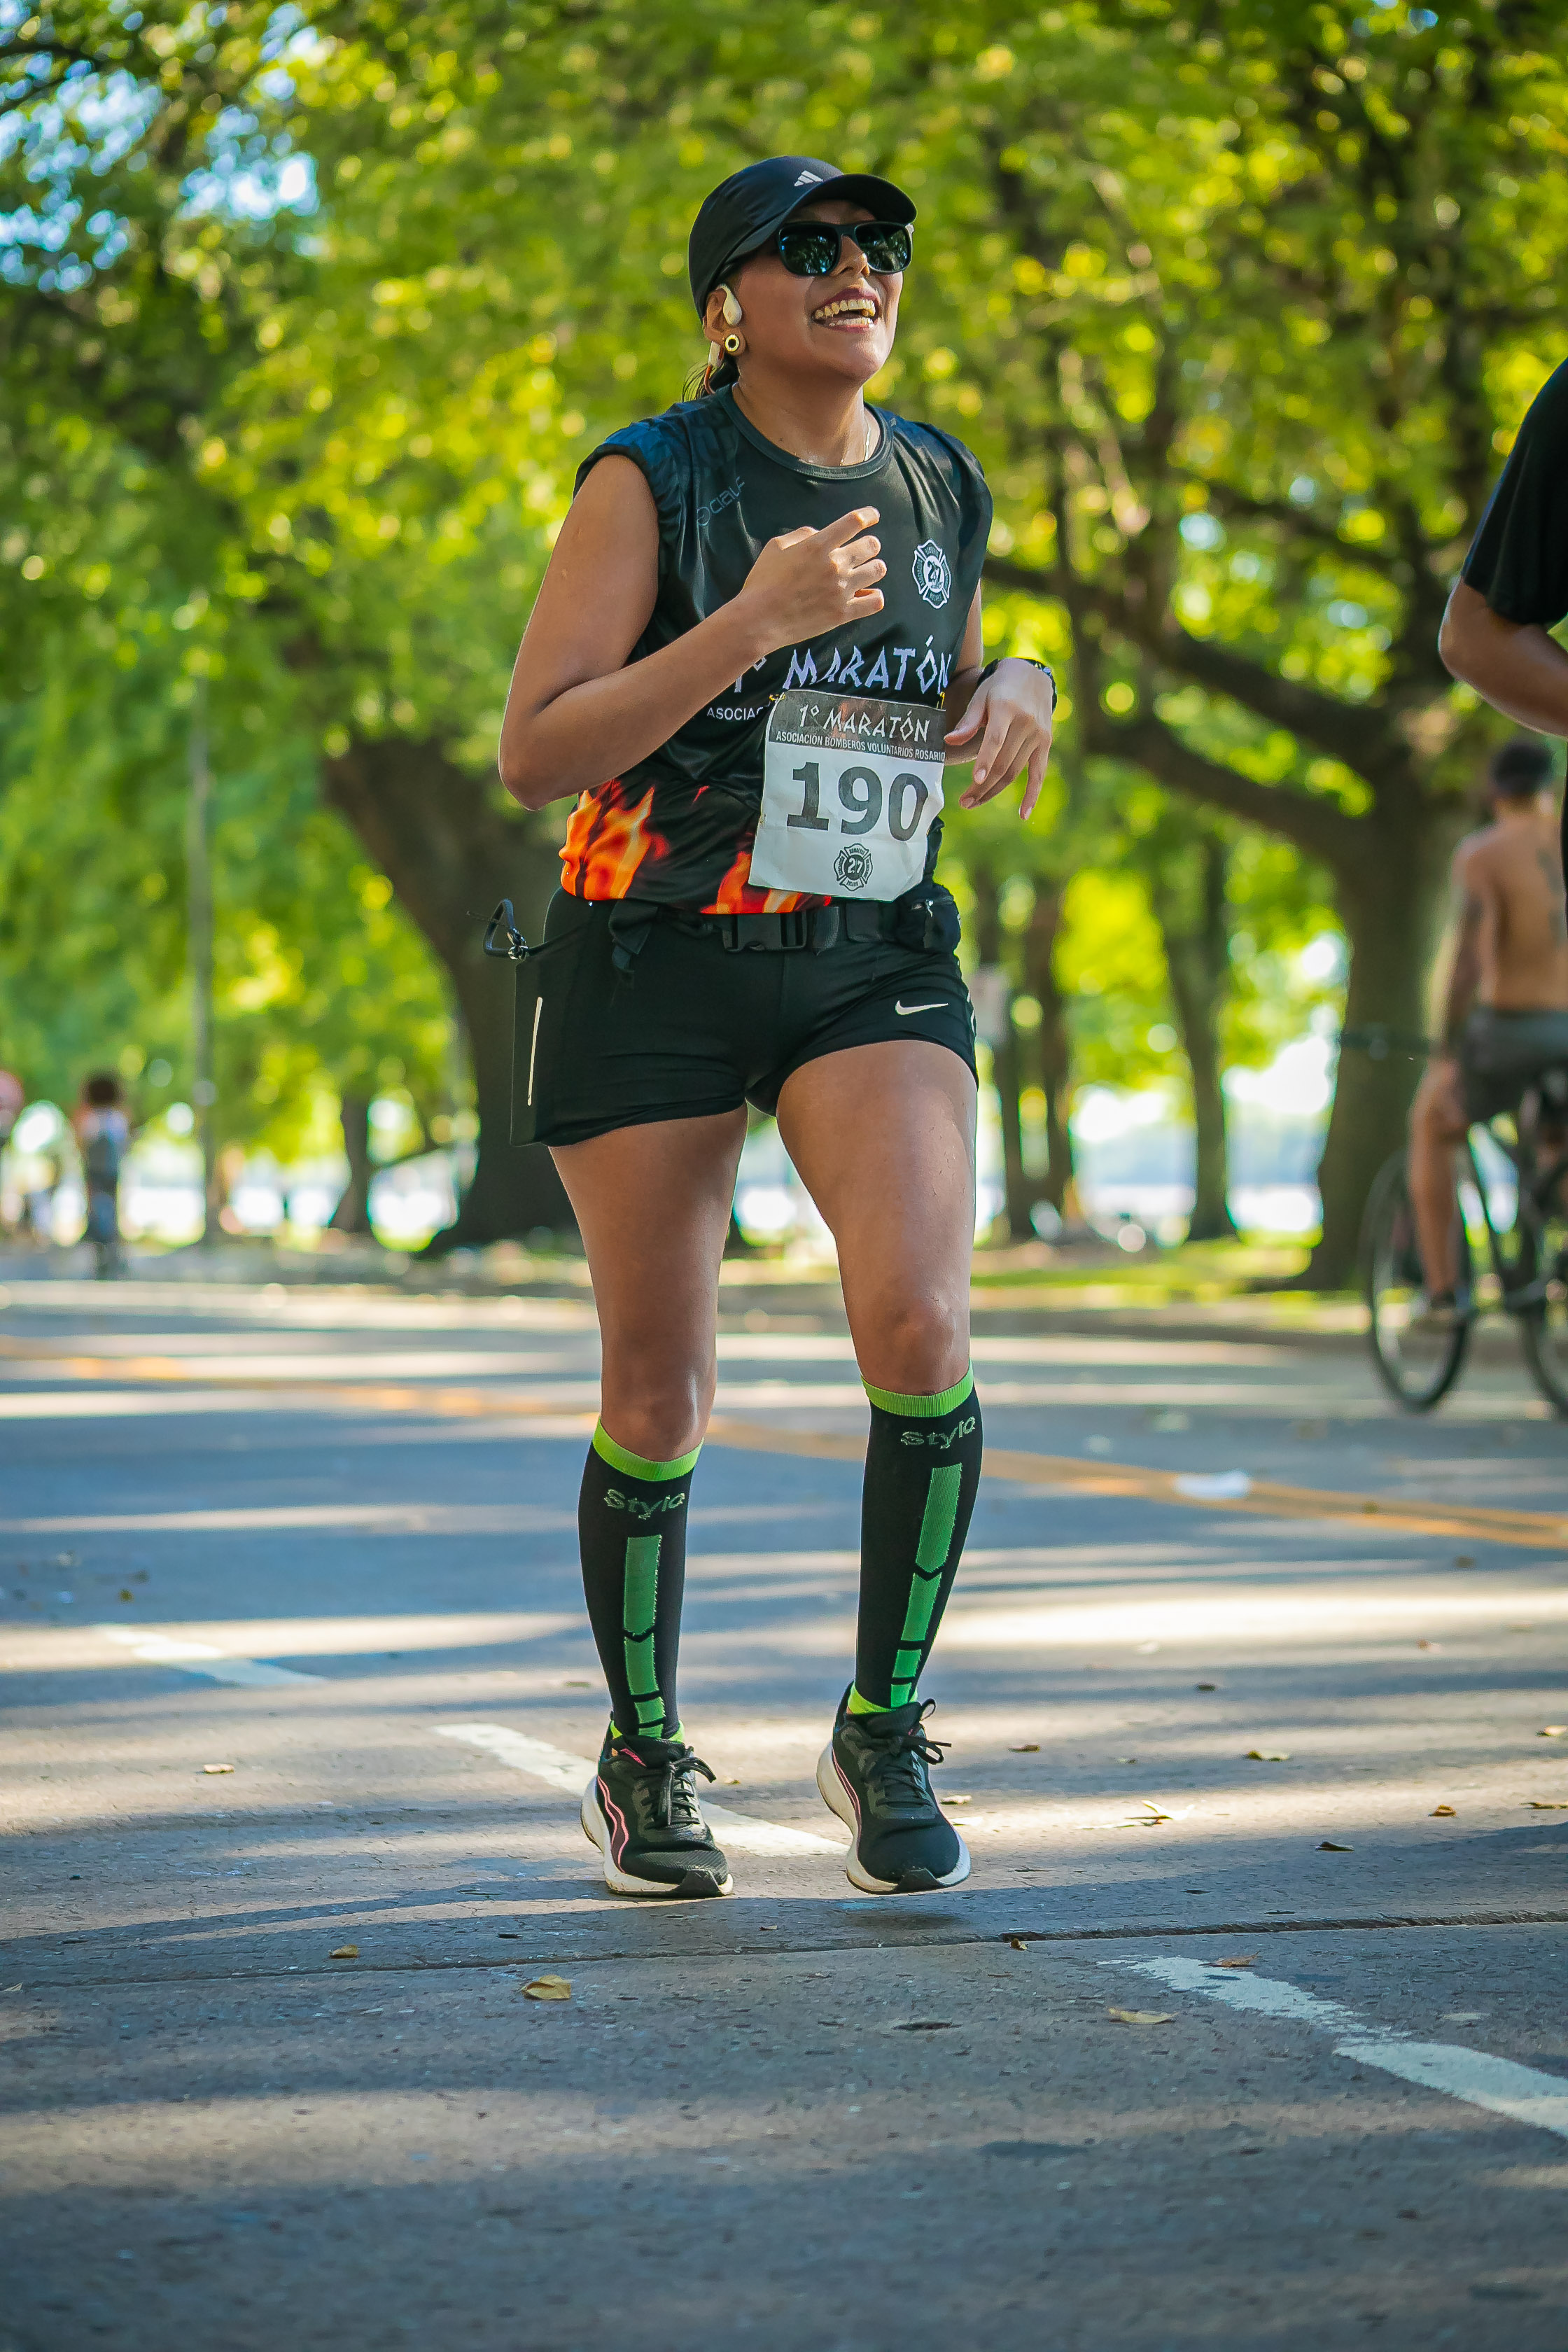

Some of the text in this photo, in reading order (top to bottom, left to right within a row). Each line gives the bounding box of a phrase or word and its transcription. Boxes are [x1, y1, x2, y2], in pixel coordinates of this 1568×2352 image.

[782, 634, 952, 694] MARATÓN
[822, 707, 930, 743] MARATÓN
[825, 736, 866, 751] BOMBEROS
[867, 741, 913, 758] VOLUNTARIOS
[914, 748, 946, 762] ROSARIO
[786, 761, 929, 841] 190
[847, 857, 863, 874] 27
